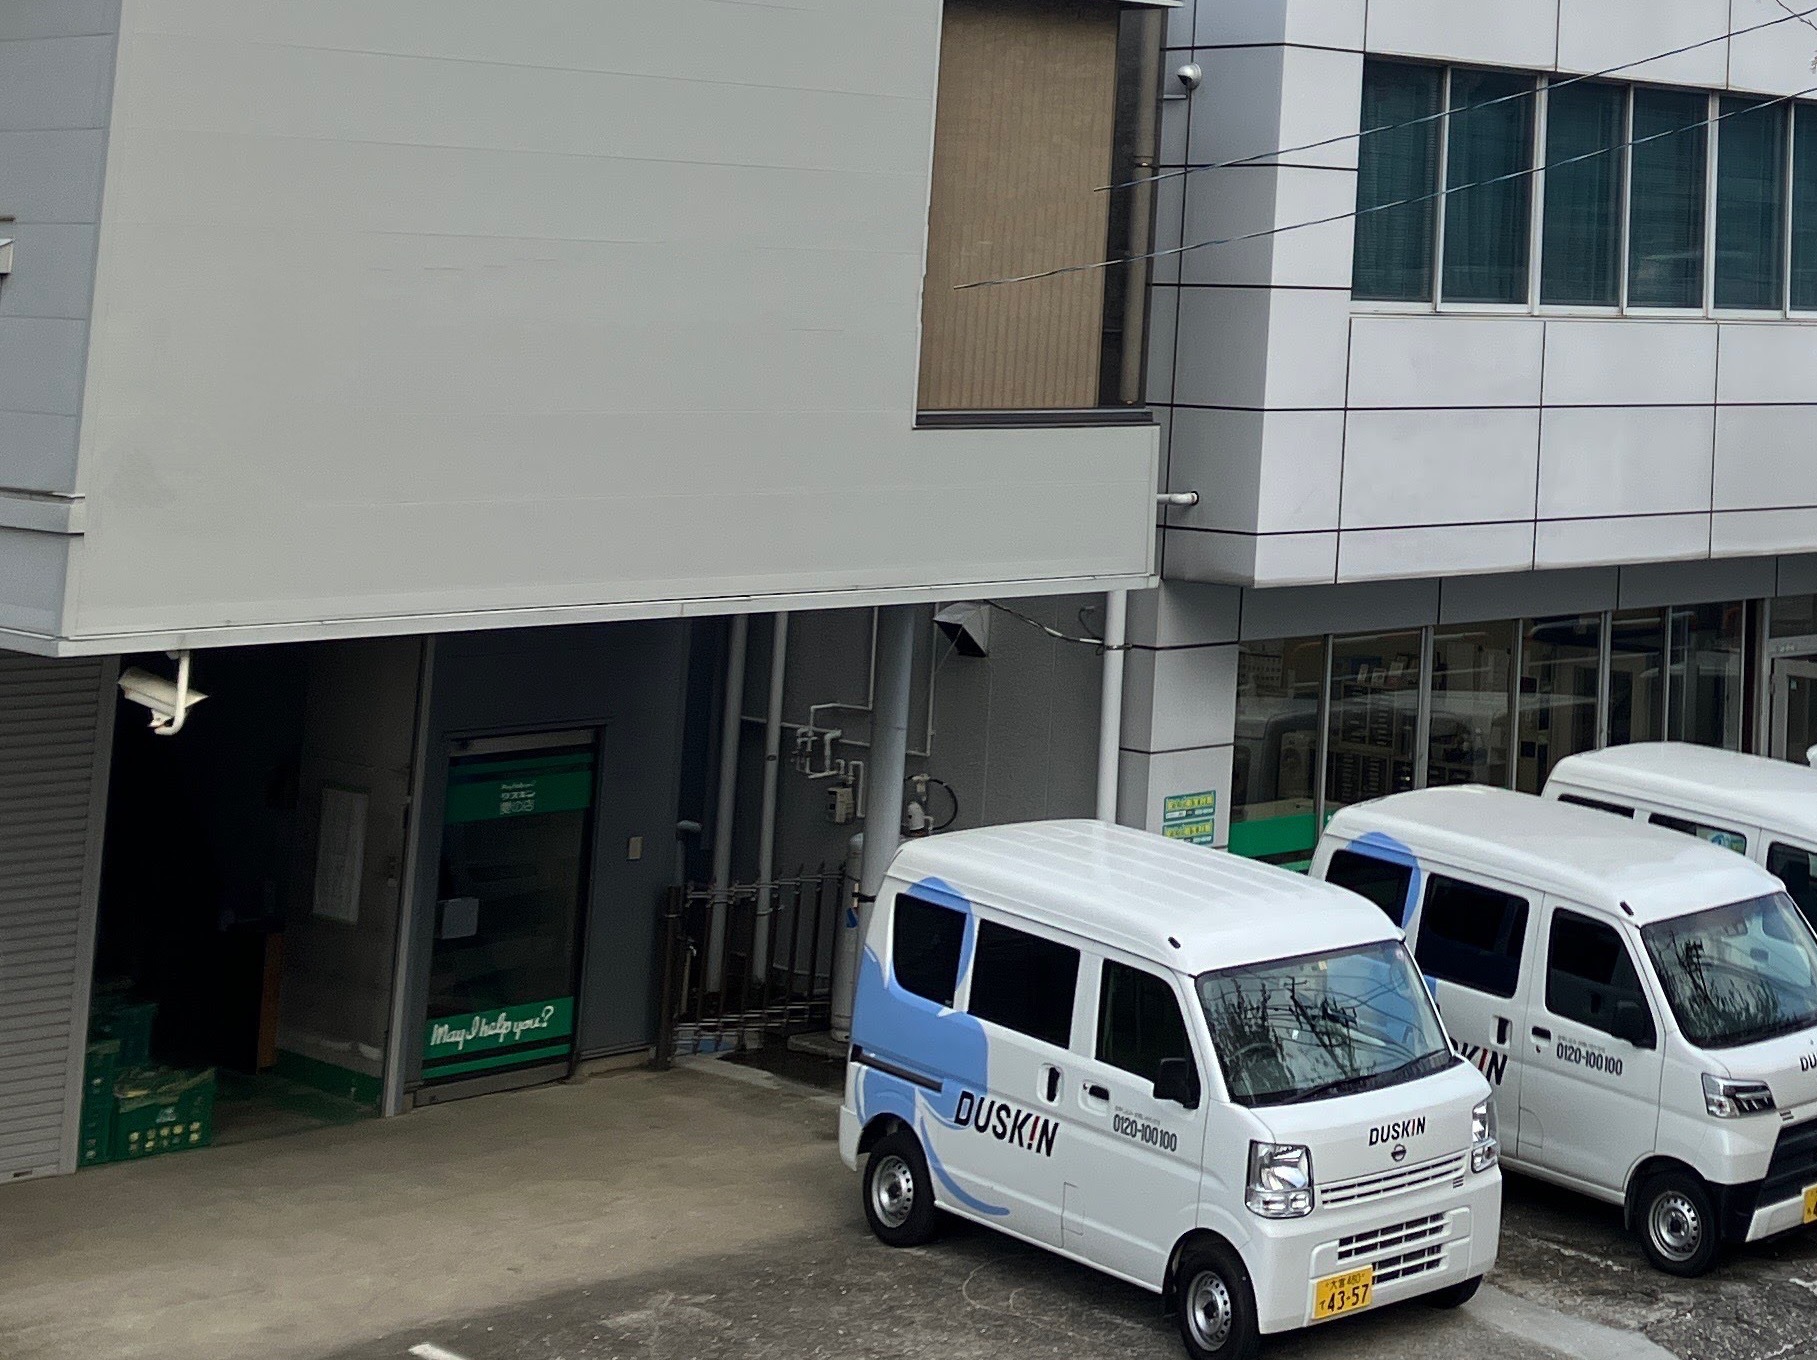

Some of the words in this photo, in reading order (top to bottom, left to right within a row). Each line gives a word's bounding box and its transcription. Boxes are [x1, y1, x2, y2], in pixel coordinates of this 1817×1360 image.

[430, 1024, 466, 1050] May
[479, 1012, 512, 1042] help
[513, 1006, 555, 1040] you?
[1327, 1283, 1369, 1311] 43-57
